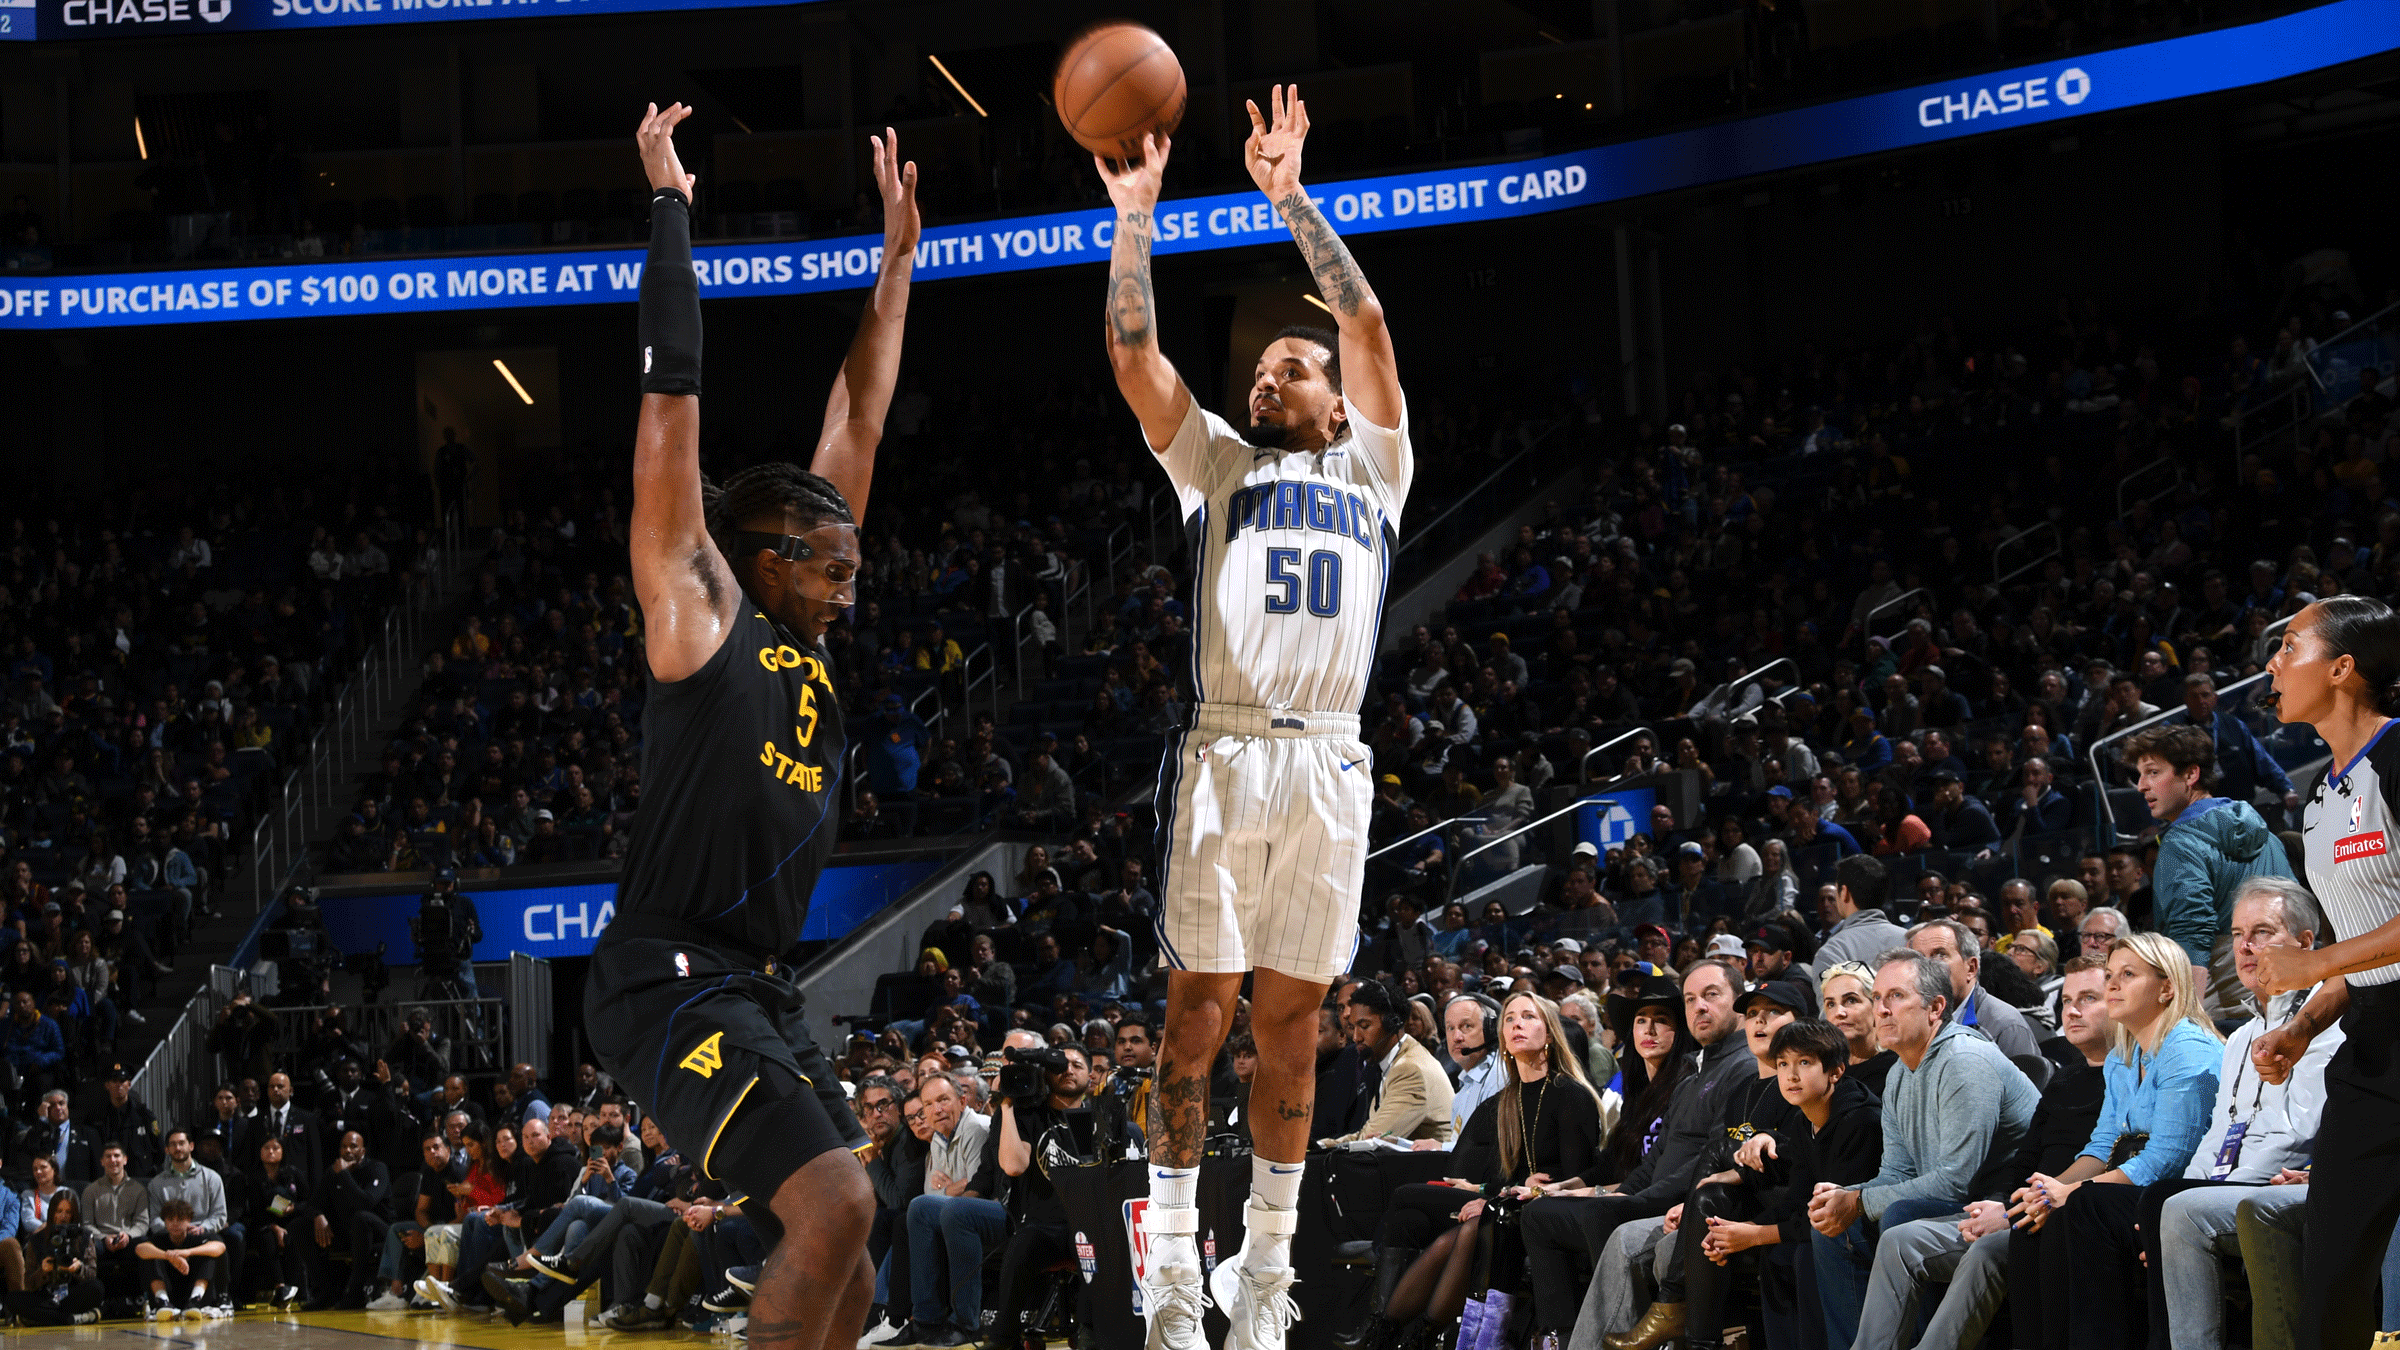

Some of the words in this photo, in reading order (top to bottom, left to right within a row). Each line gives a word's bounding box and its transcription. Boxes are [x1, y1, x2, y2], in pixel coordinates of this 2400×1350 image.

[63, 0, 192, 26] CHASE
[1918, 76, 2050, 128] CHASE
[59, 281, 239, 316] PURCHASE
[247, 278, 292, 307] OF
[300, 274, 380, 306] $100
[387, 268, 439, 300] OR
[447, 266, 548, 298] MORE
[555, 264, 599, 293] AT
[606, 256, 793, 290] WRIORS
[801, 246, 885, 281] SHOP
[991, 224, 1085, 258] YOUR
[1092, 211, 1199, 248] CSE
[1333, 191, 1385, 222] OR
[1392, 179, 1489, 216] DEBIT
[1497, 164, 1588, 204] CARD
[1225, 479, 1373, 553] MAGIC
[1265, 546, 1343, 619] 50
[796, 683, 818, 748] 5
[759, 741, 822, 793] STATE
[2334, 837, 2384, 859] Emirates
[523, 900, 616, 942] CHA
[1076, 1244, 1094, 1258] ENTER
